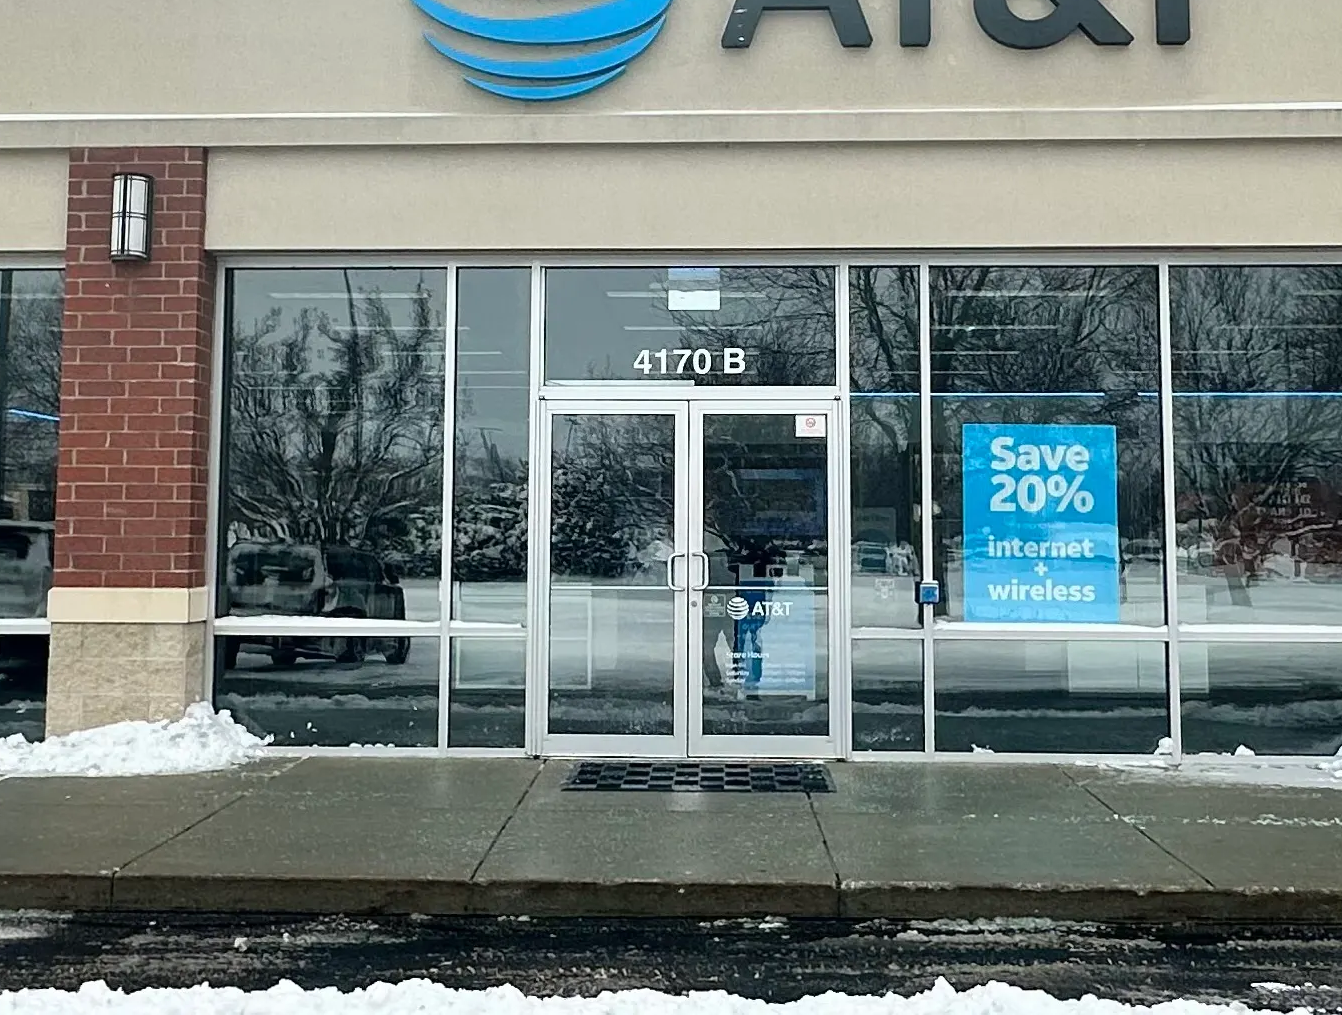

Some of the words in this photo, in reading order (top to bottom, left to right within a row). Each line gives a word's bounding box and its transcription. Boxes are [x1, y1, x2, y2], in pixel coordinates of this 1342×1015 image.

[633, 348, 712, 375] 4170
[723, 347, 746, 375] B
[990, 436, 1090, 472] Save
[989, 474, 1095, 514] 20%
[988, 535, 1095, 558] internet
[987, 578, 1097, 602] wireless
[751, 601, 794, 616] AT&T
[726, 651, 746, 659] Store
[748, 651, 770, 659] Hours
